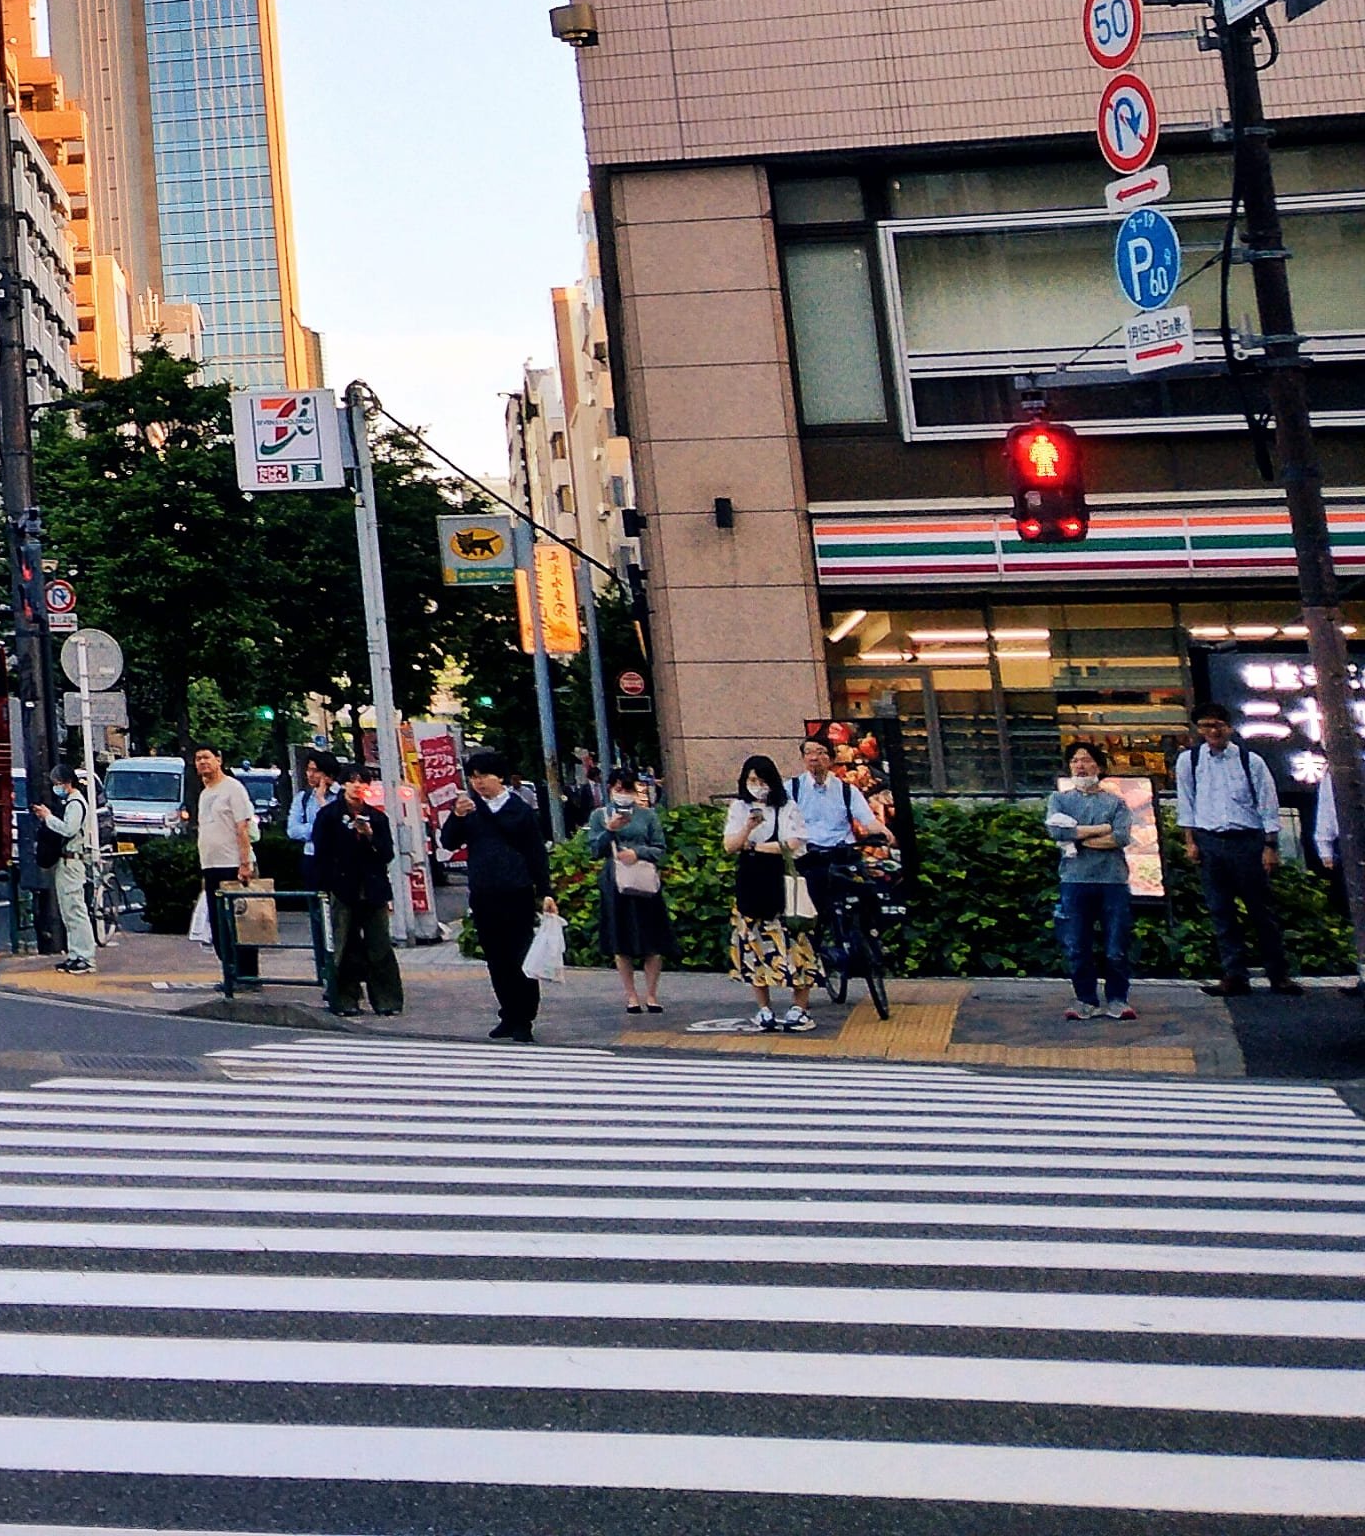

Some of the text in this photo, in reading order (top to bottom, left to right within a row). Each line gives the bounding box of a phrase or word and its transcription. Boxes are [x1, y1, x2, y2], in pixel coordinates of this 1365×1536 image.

[1128, 213, 1156, 233] 9-19
[1127, 237, 1154, 301] P
[1149, 266, 1169, 297] 60
[258, 466, 287, 482] たばこ
[425, 765, 456, 780] チェック
